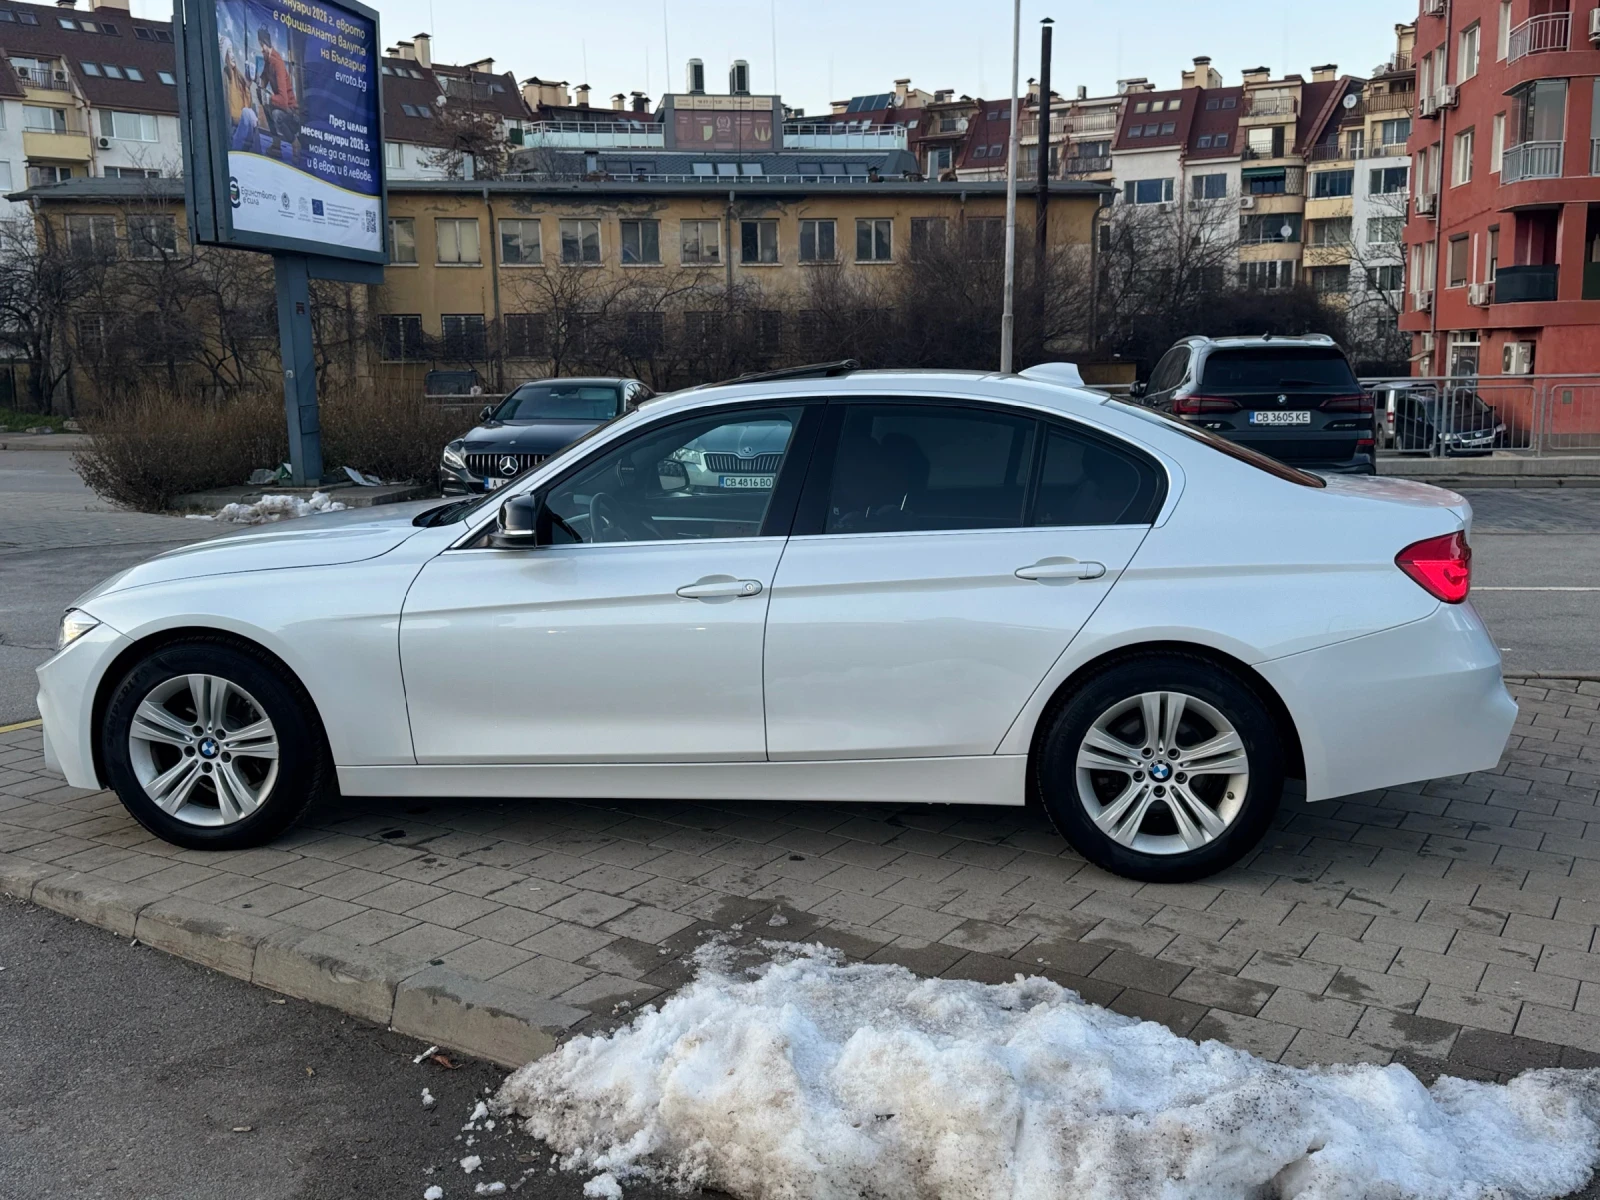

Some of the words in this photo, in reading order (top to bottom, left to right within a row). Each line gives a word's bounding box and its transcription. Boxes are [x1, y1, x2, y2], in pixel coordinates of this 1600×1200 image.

[273, 10, 279, 20] е
[280, 13, 337, 44] официалната
[338, 36, 366, 56] валута
[312, 6, 328, 23] 2026
[336, 18, 366, 39] еврото
[320, 48, 330, 60] на
[331, 51, 366, 73] България
[335, 72, 367, 92] evroto.bg
[329, 114, 346, 131] През
[347, 121, 368, 135] целия
[300, 125, 323, 141] месец
[324, 132, 349, 147] януари
[309, 144, 327, 156] може
[328, 149, 337, 160] да
[338, 151, 346, 161] се
[347, 154, 370, 167] плаща
[307, 159, 312, 168] и
[312, 158, 318, 169] в
[318, 160, 337, 175] евро,
[337, 166, 342, 175] и
[343, 165, 348, 177] в
[348, 168, 373, 182] левове.
[1256, 412, 1268, 422] CB
[1270, 412, 1294, 422] 3605
[1295, 412, 1309, 422] KE
[725, 478, 737, 487] CB
[738, 478, 759, 487] 4816
